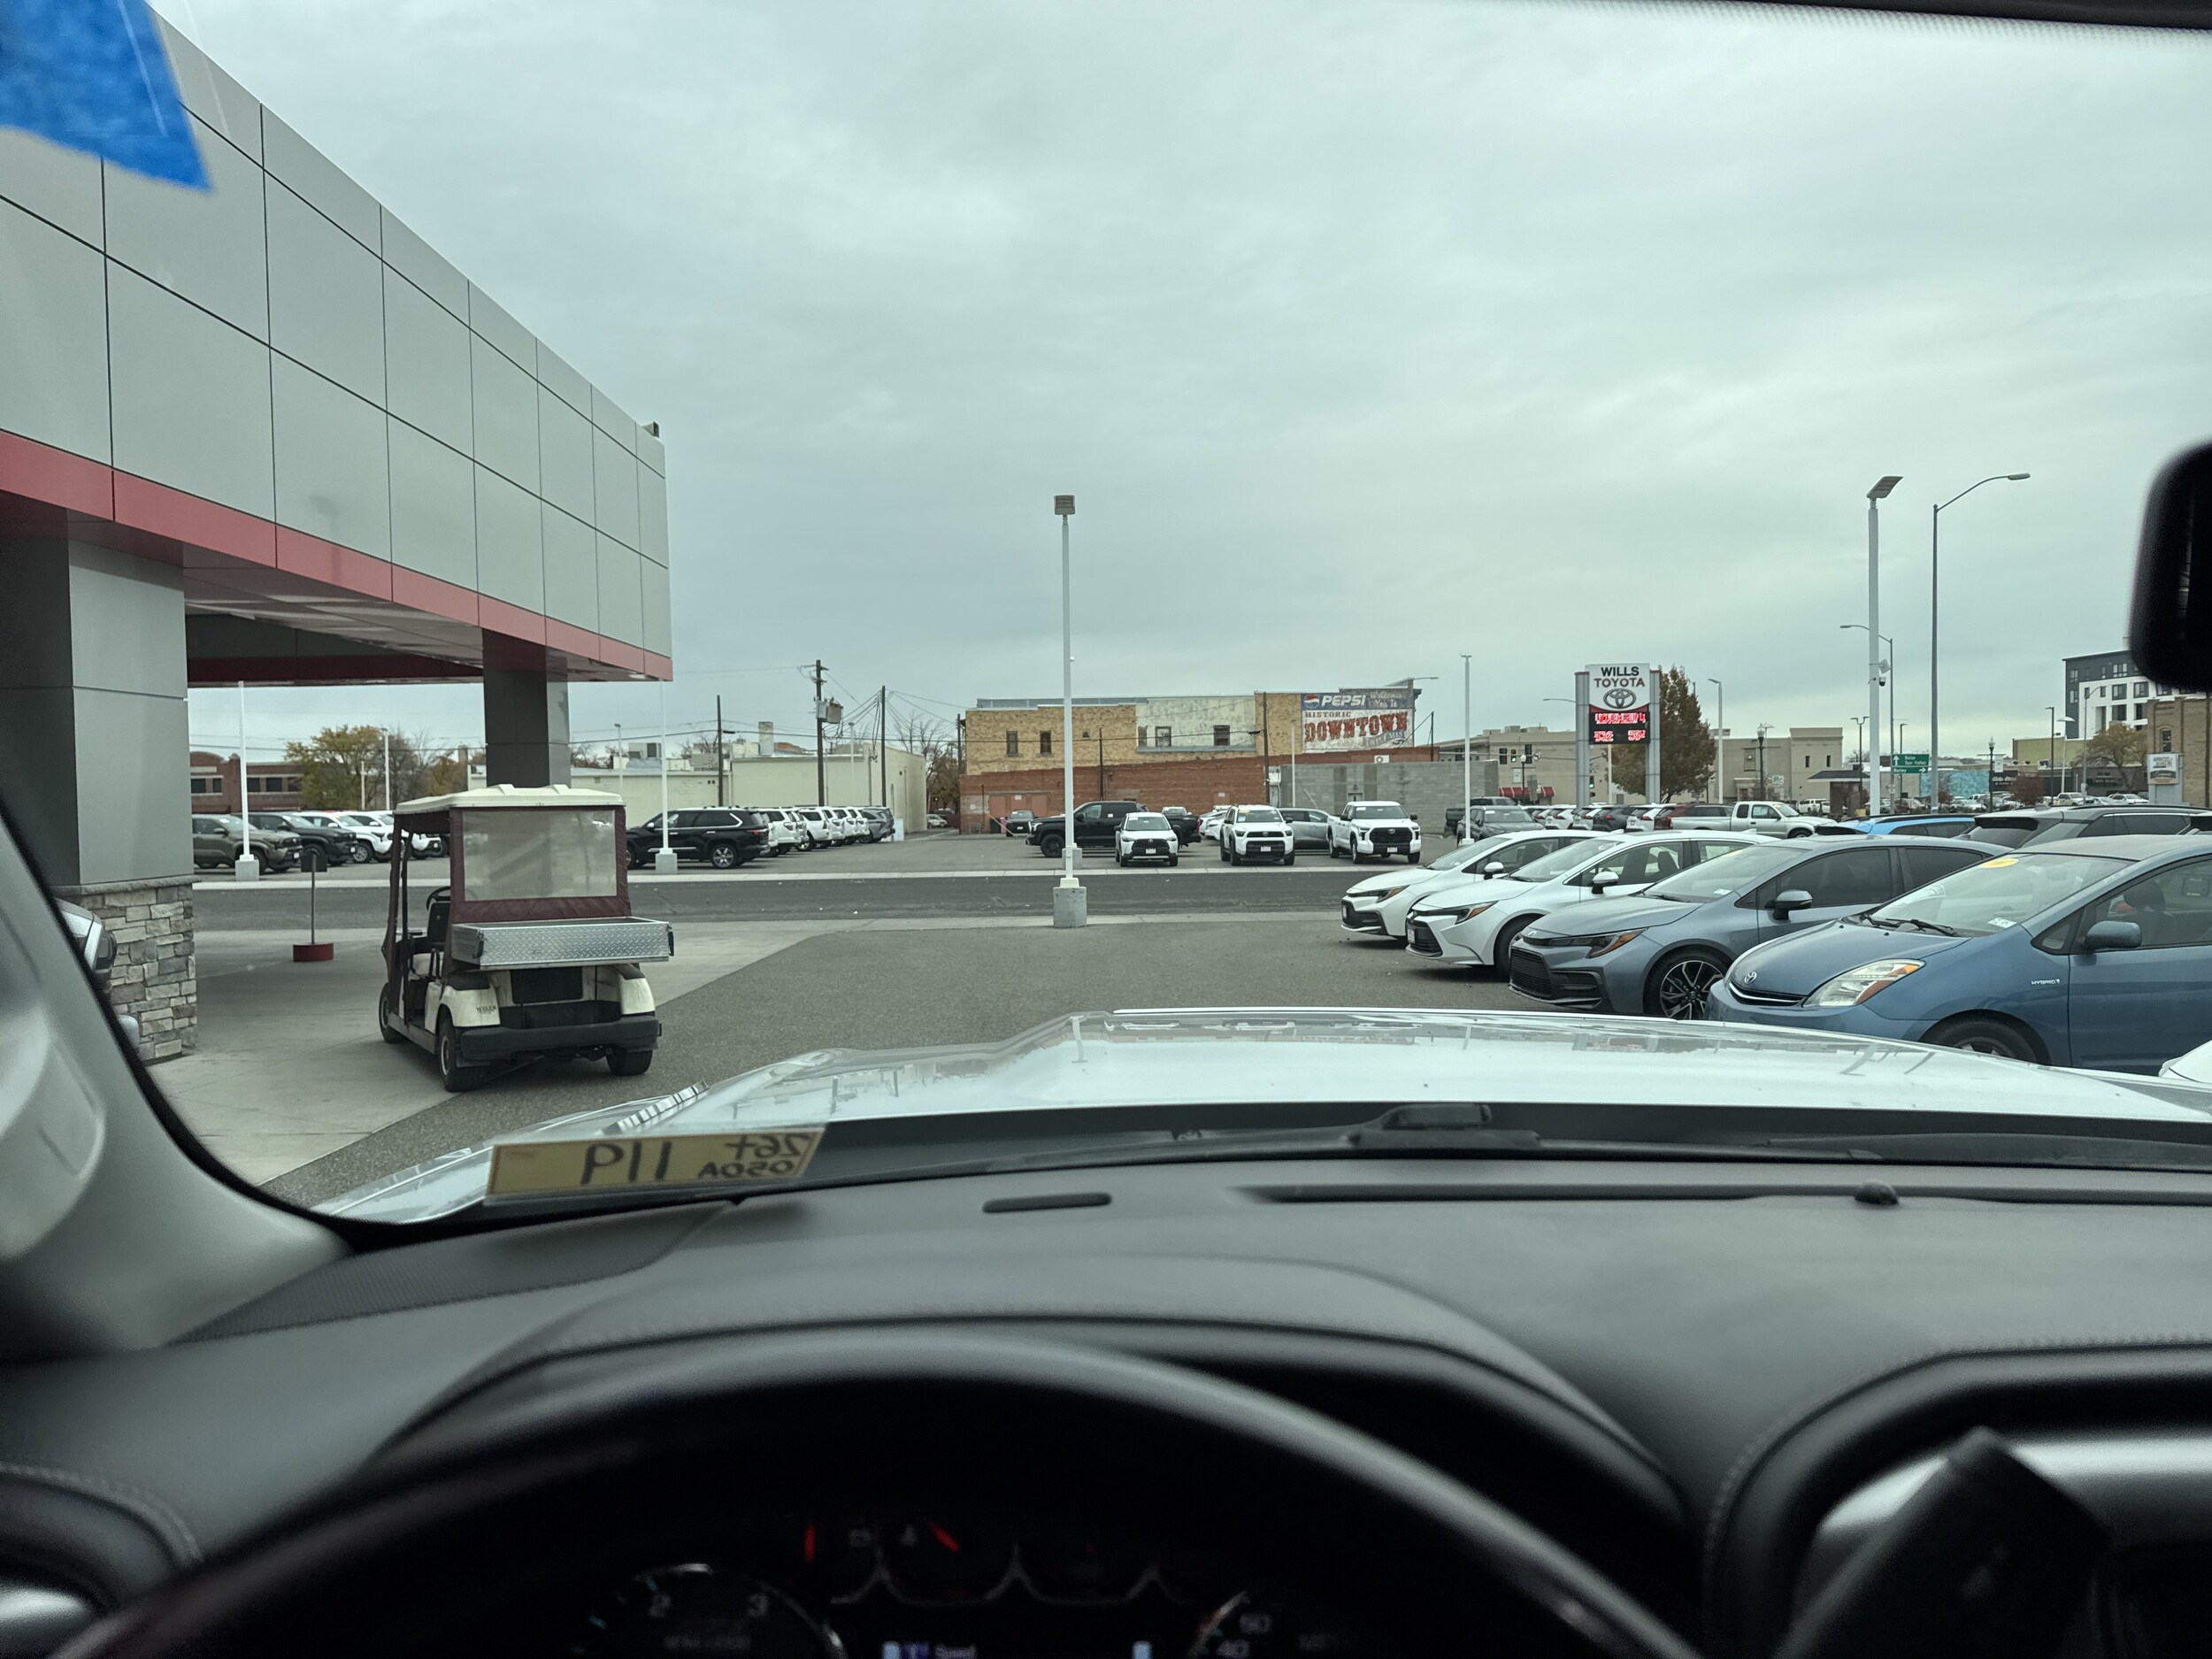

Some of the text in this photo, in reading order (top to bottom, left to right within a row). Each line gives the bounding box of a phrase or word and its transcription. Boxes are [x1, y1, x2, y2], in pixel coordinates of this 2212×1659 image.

[1601, 666, 1639, 676] WILLS
[1594, 678, 1645, 687] TOYOTA
[1322, 695, 1366, 706] PEPSI
[1305, 711, 1408, 741] DOWNTOWN
